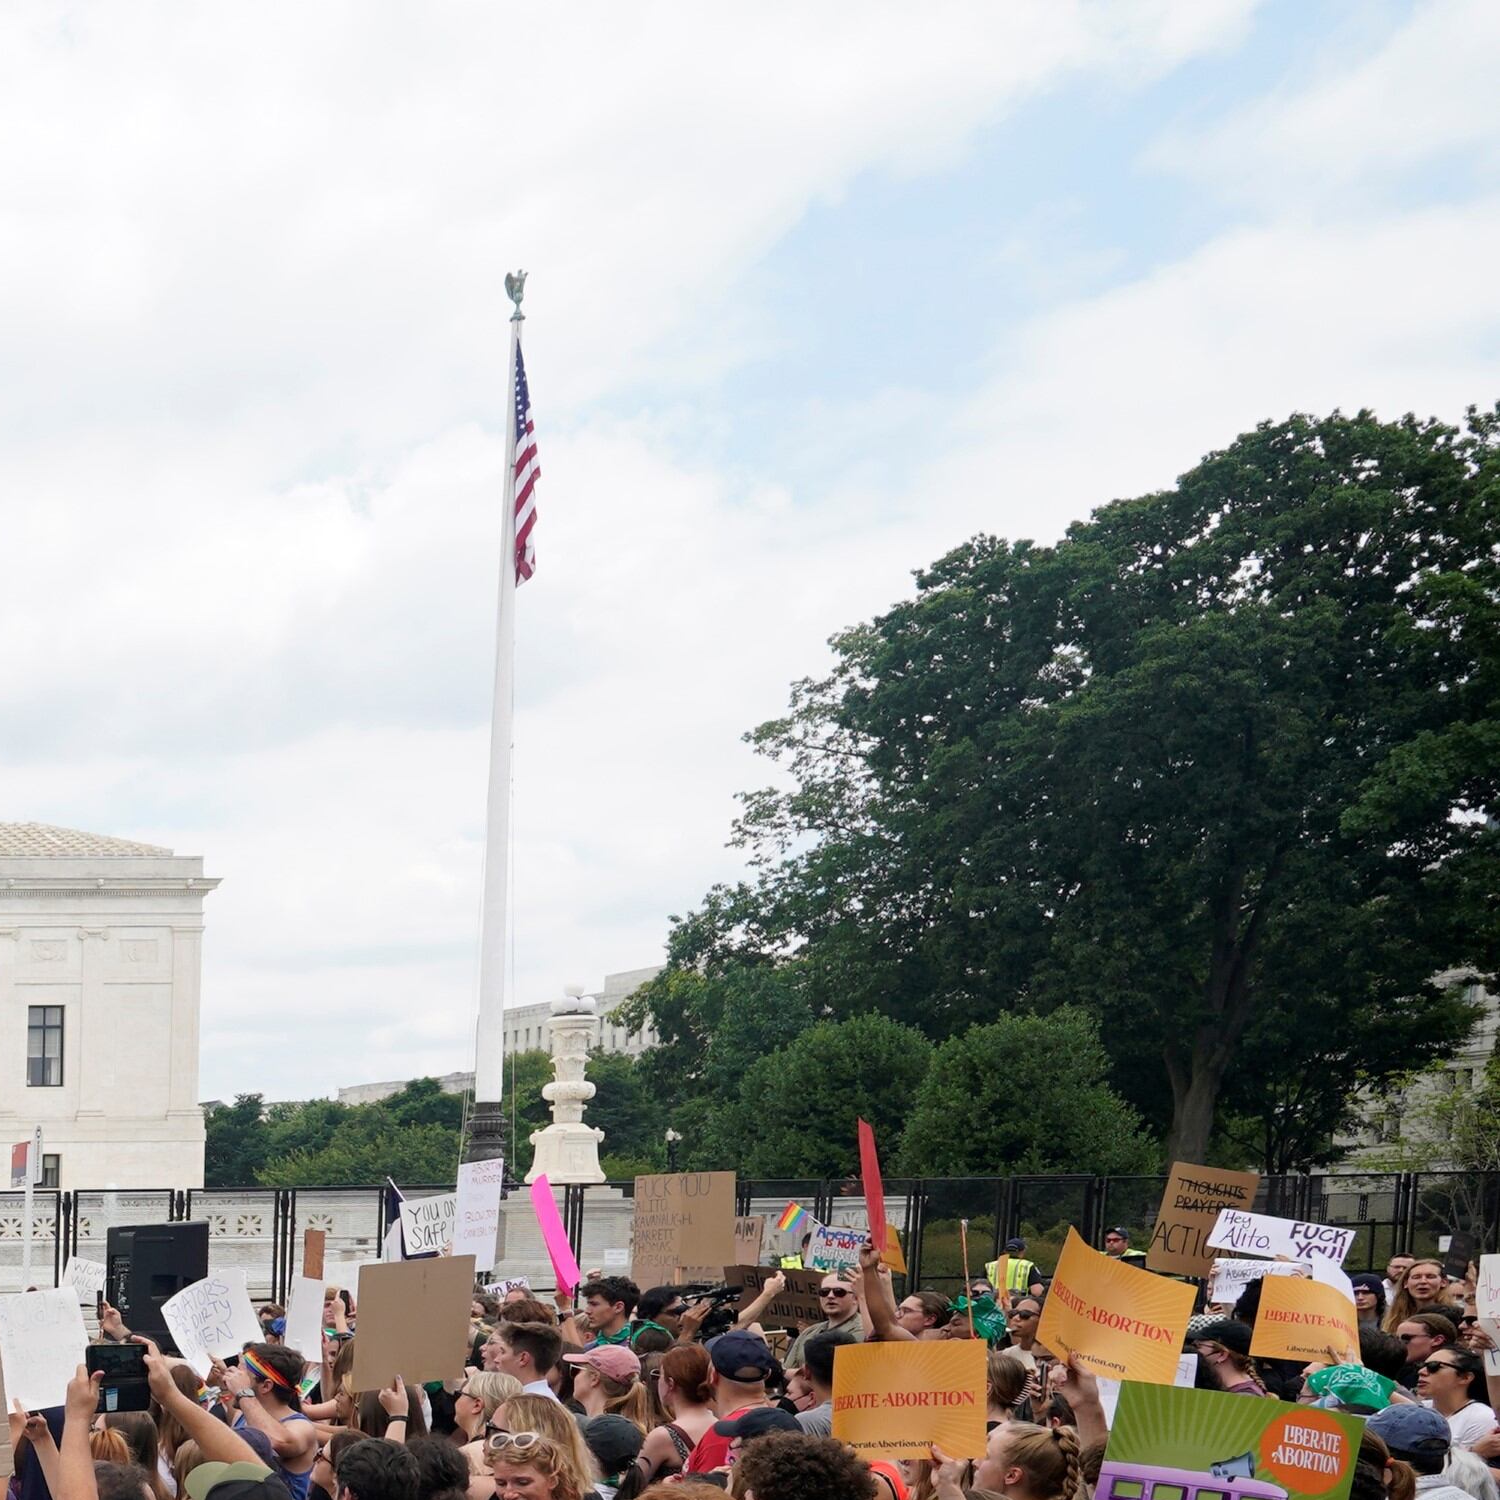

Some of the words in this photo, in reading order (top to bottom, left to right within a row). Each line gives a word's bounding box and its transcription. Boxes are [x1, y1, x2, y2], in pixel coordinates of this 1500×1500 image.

[635, 1178, 673, 1198] FUCK
[677, 1174, 711, 1197] YOU
[408, 1203, 439, 1224] YOU
[1224, 1211, 1252, 1230] Hey
[816, 1227, 866, 1243] America
[837, 1240, 857, 1250] NOT
[1289, 1222, 1349, 1247] FUCK
[1086, 1305, 1175, 1345] ABORTION
[1264, 1310, 1326, 1326] LIBERATE
[882, 1391, 976, 1408] ABORTION
[1283, 1424, 1342, 1454] LIBERATE
[1271, 1444, 1340, 1476] ABORTION
